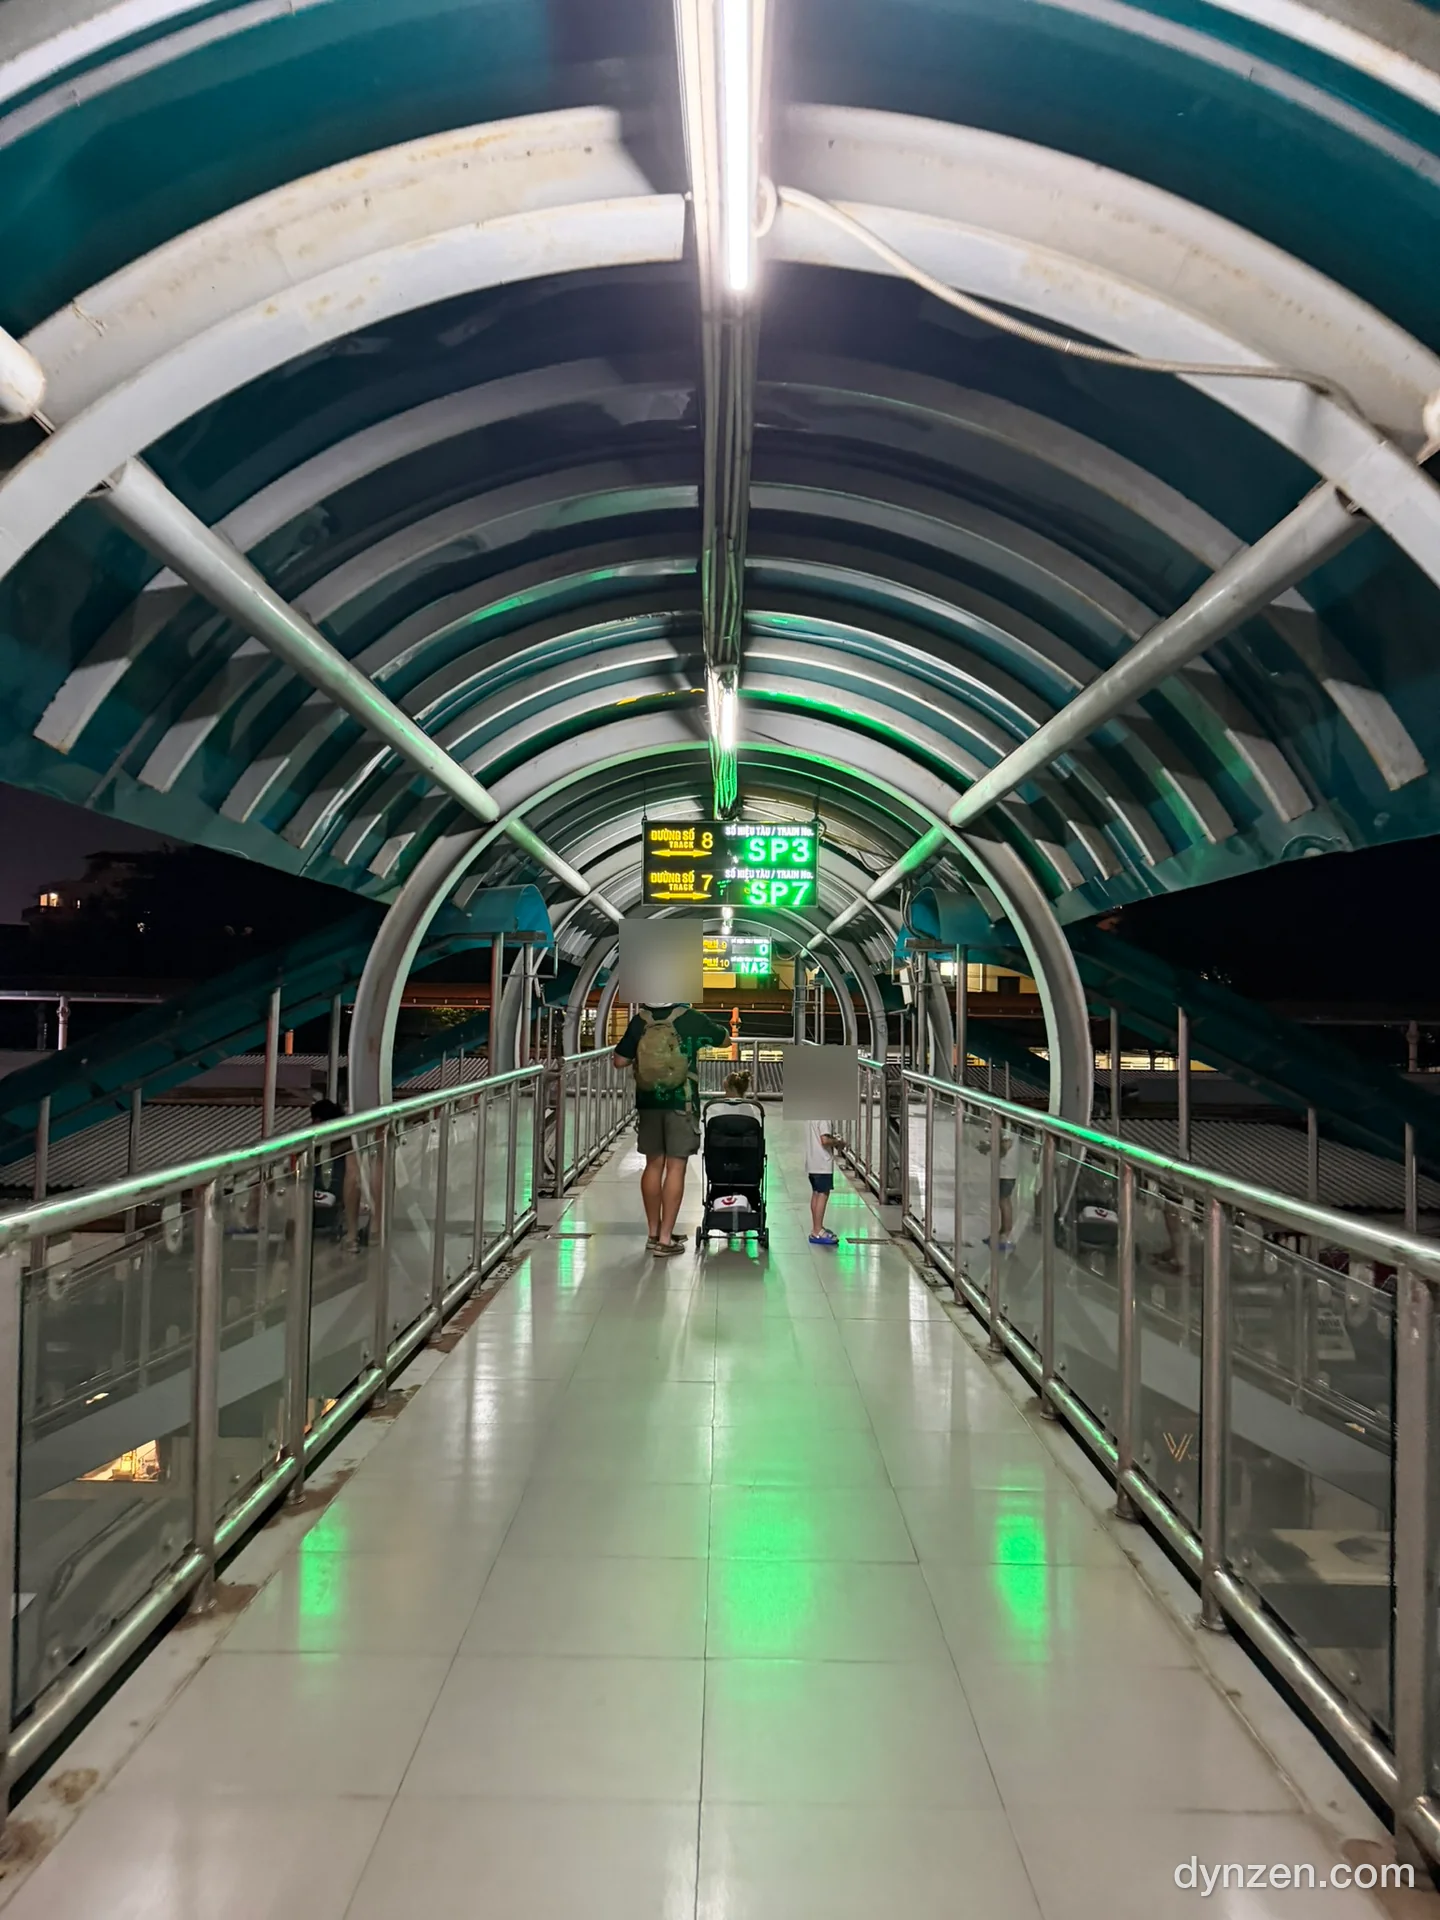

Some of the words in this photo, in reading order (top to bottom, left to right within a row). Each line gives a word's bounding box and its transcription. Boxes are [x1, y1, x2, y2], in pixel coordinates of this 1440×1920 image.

[725, 823, 736, 836] SỐ
[756, 825, 771, 836] TÀU
[777, 826, 800, 836] TRAIN
[651, 828, 681, 841] ĐƯỜNG
[682, 827, 695, 841] SỐ
[701, 831, 713, 849] 8
[669, 841, 694, 849] TRACK
[748, 837, 810, 863] SP3
[725, 867, 736, 878] SỐ
[755, 868, 770, 879] TÀU
[776, 869, 799, 879] TRAIN
[650, 870, 681, 883] ĐƯỜNG
[682, 869, 695, 883] SỐ
[701, 874, 713, 891] 7
[669, 883, 694, 891] TRACK
[749, 881, 811, 906] SP7
[720, 959, 730, 968] 10
[741, 961, 769, 974] NA2
